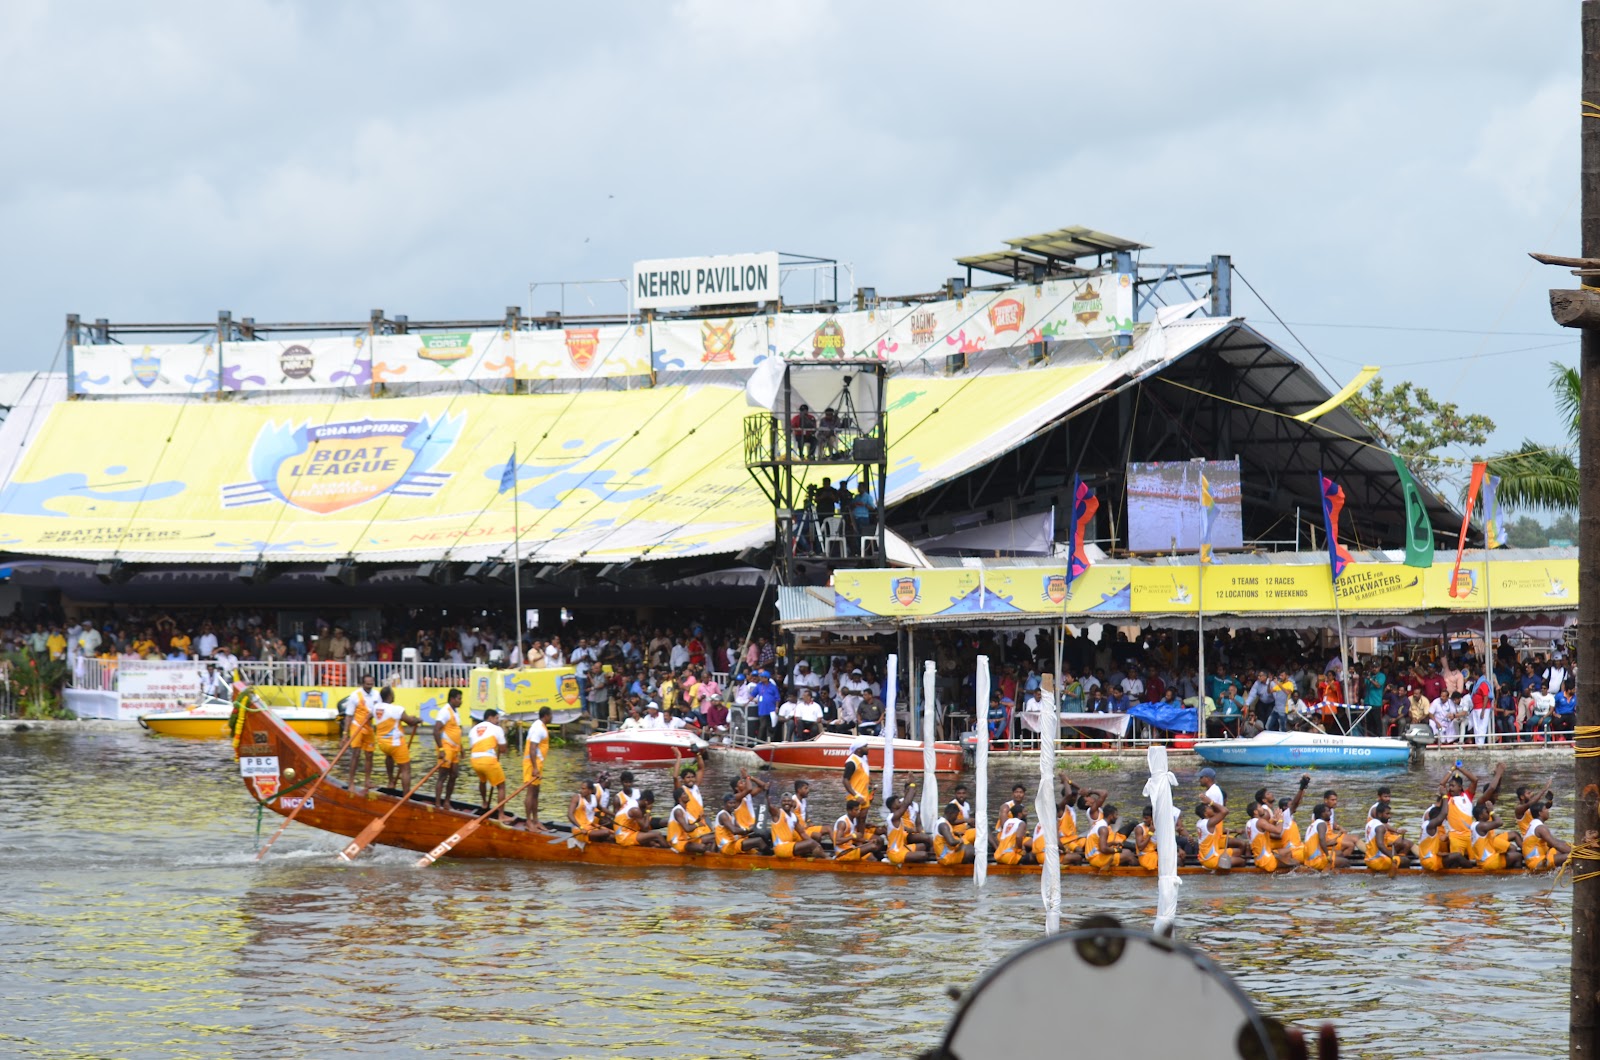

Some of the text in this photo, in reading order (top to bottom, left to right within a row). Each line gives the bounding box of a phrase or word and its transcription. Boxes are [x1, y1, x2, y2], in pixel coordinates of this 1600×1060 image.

[638, 264, 768, 298] NEHRU PAVILION
[315, 423, 409, 438] CHAMPIONS
[312, 446, 390, 462] BOAT
[290, 459, 399, 477] LEAGUE
[1410, 492, 1429, 541] 2
[56, 530, 182, 542] BACKWATERS
[61, 527, 124, 536] BATTLE
[409, 523, 542, 542] NEROLAC
[1231, 577, 1295, 585] 9 TEAMS 12 RACES
[1340, 571, 1373, 587] BATTLE
[1342, 574, 1401, 597] BACKWATERS
[1502, 580, 1518, 588] 67th
[1133, 585, 1147, 593] 67th
[1225, 590, 1259, 598] LOCATIONS
[1275, 589, 1308, 597] WEEKENDS
[1343, 747, 1371, 755] FIEGO
